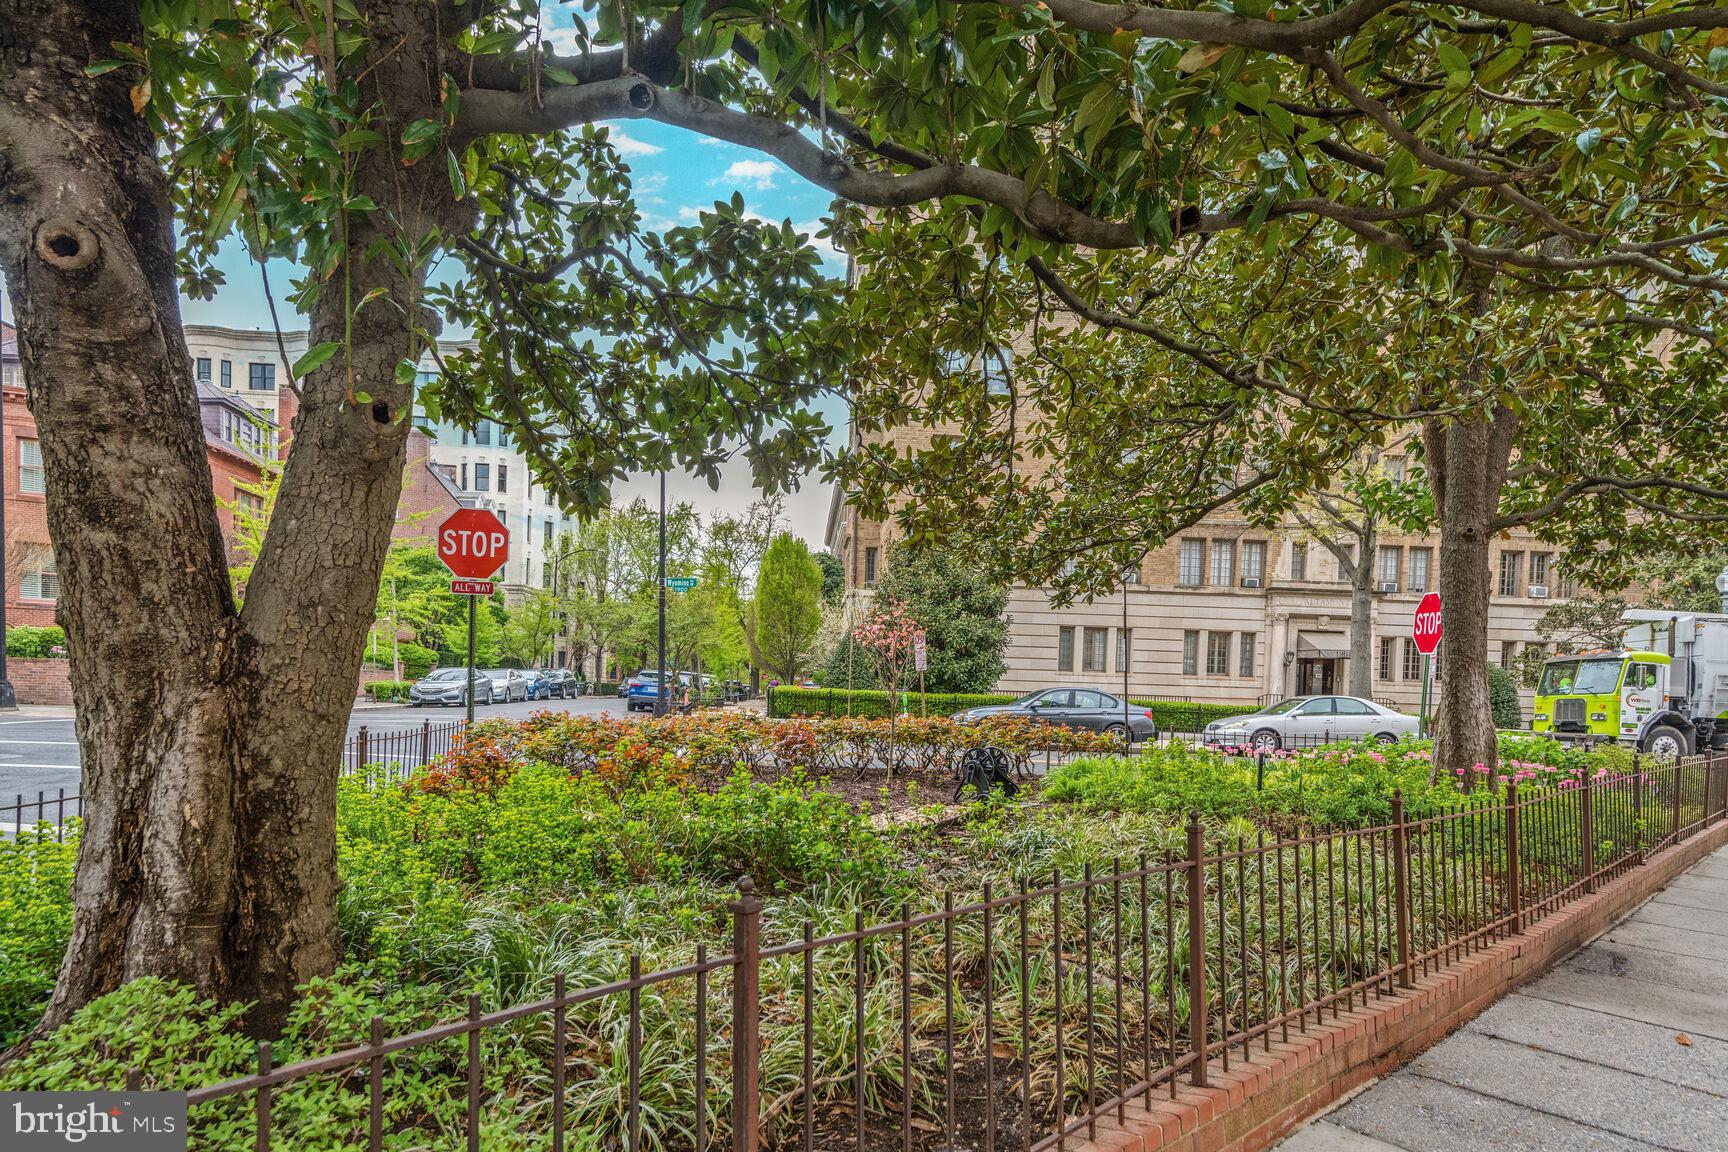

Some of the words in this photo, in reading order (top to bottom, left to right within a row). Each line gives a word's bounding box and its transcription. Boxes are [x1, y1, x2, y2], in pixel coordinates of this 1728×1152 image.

[442, 529, 505, 558] STOP
[454, 582, 471, 592] ALL
[475, 583, 491, 593] WAY
[1415, 611, 1441, 635] STOP
